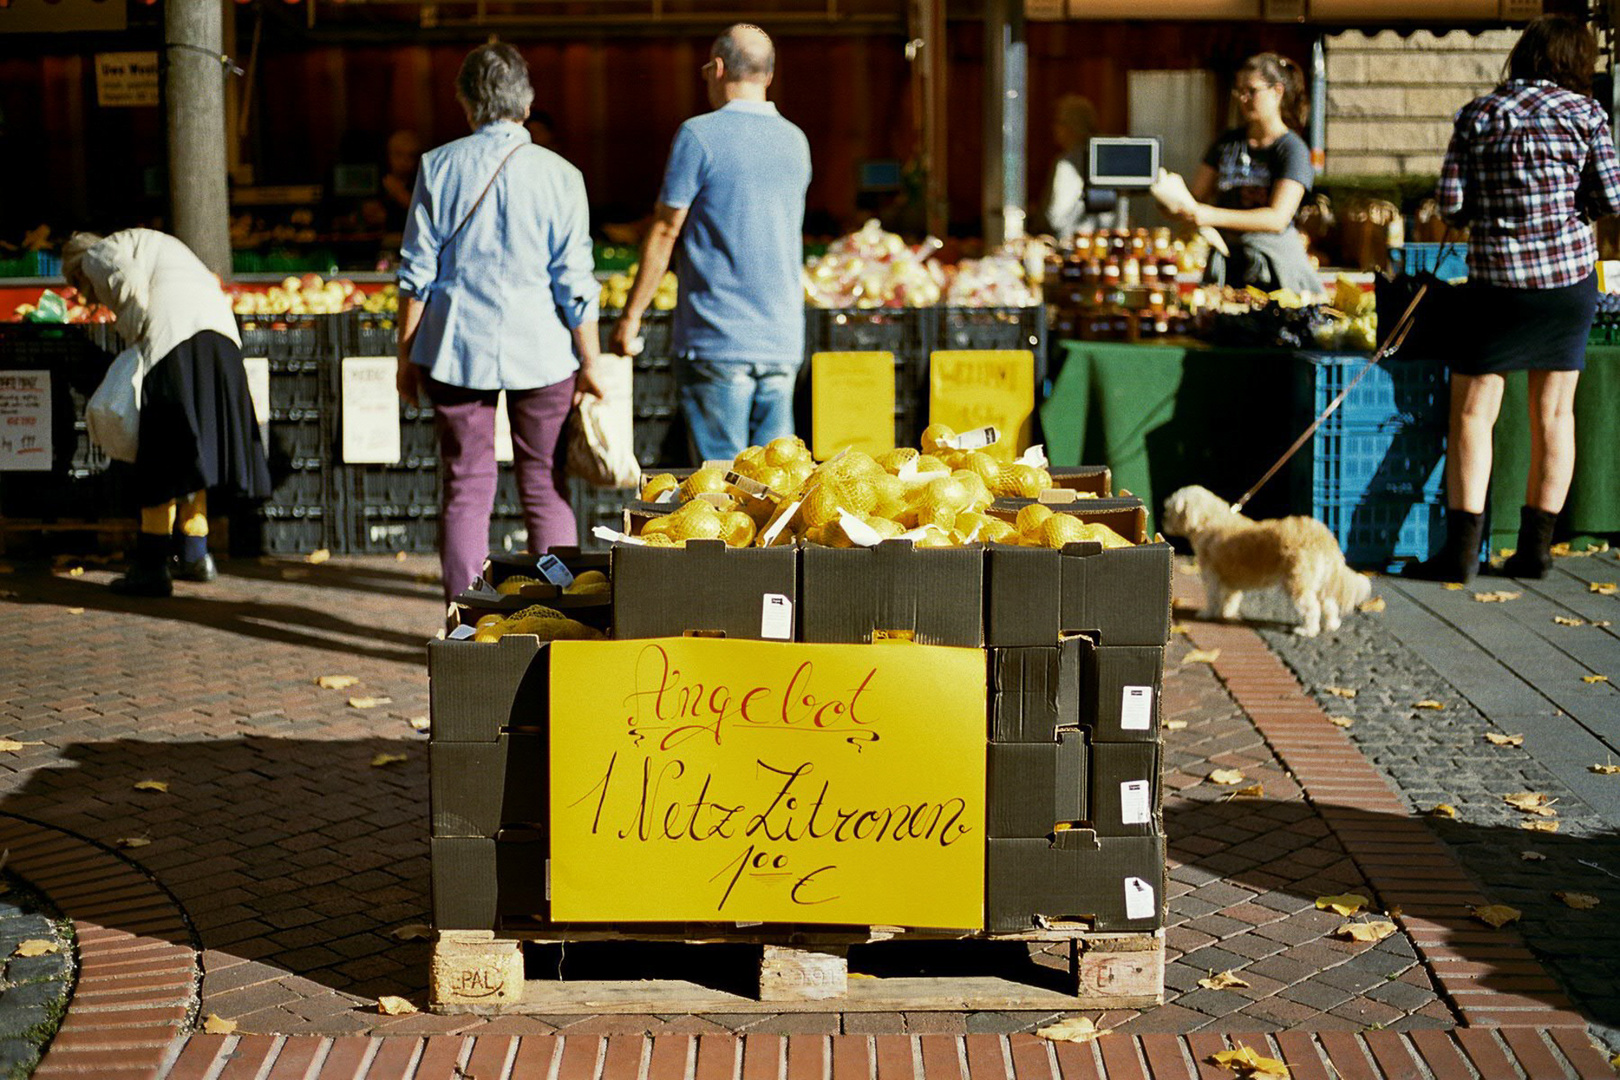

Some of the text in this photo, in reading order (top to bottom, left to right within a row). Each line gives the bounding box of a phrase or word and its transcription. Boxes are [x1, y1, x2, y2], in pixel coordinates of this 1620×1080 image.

[625, 643, 879, 750] Angebot
[567, 750, 973, 847] 1 Netz Zitronen
[790, 864, 840, 906] €
